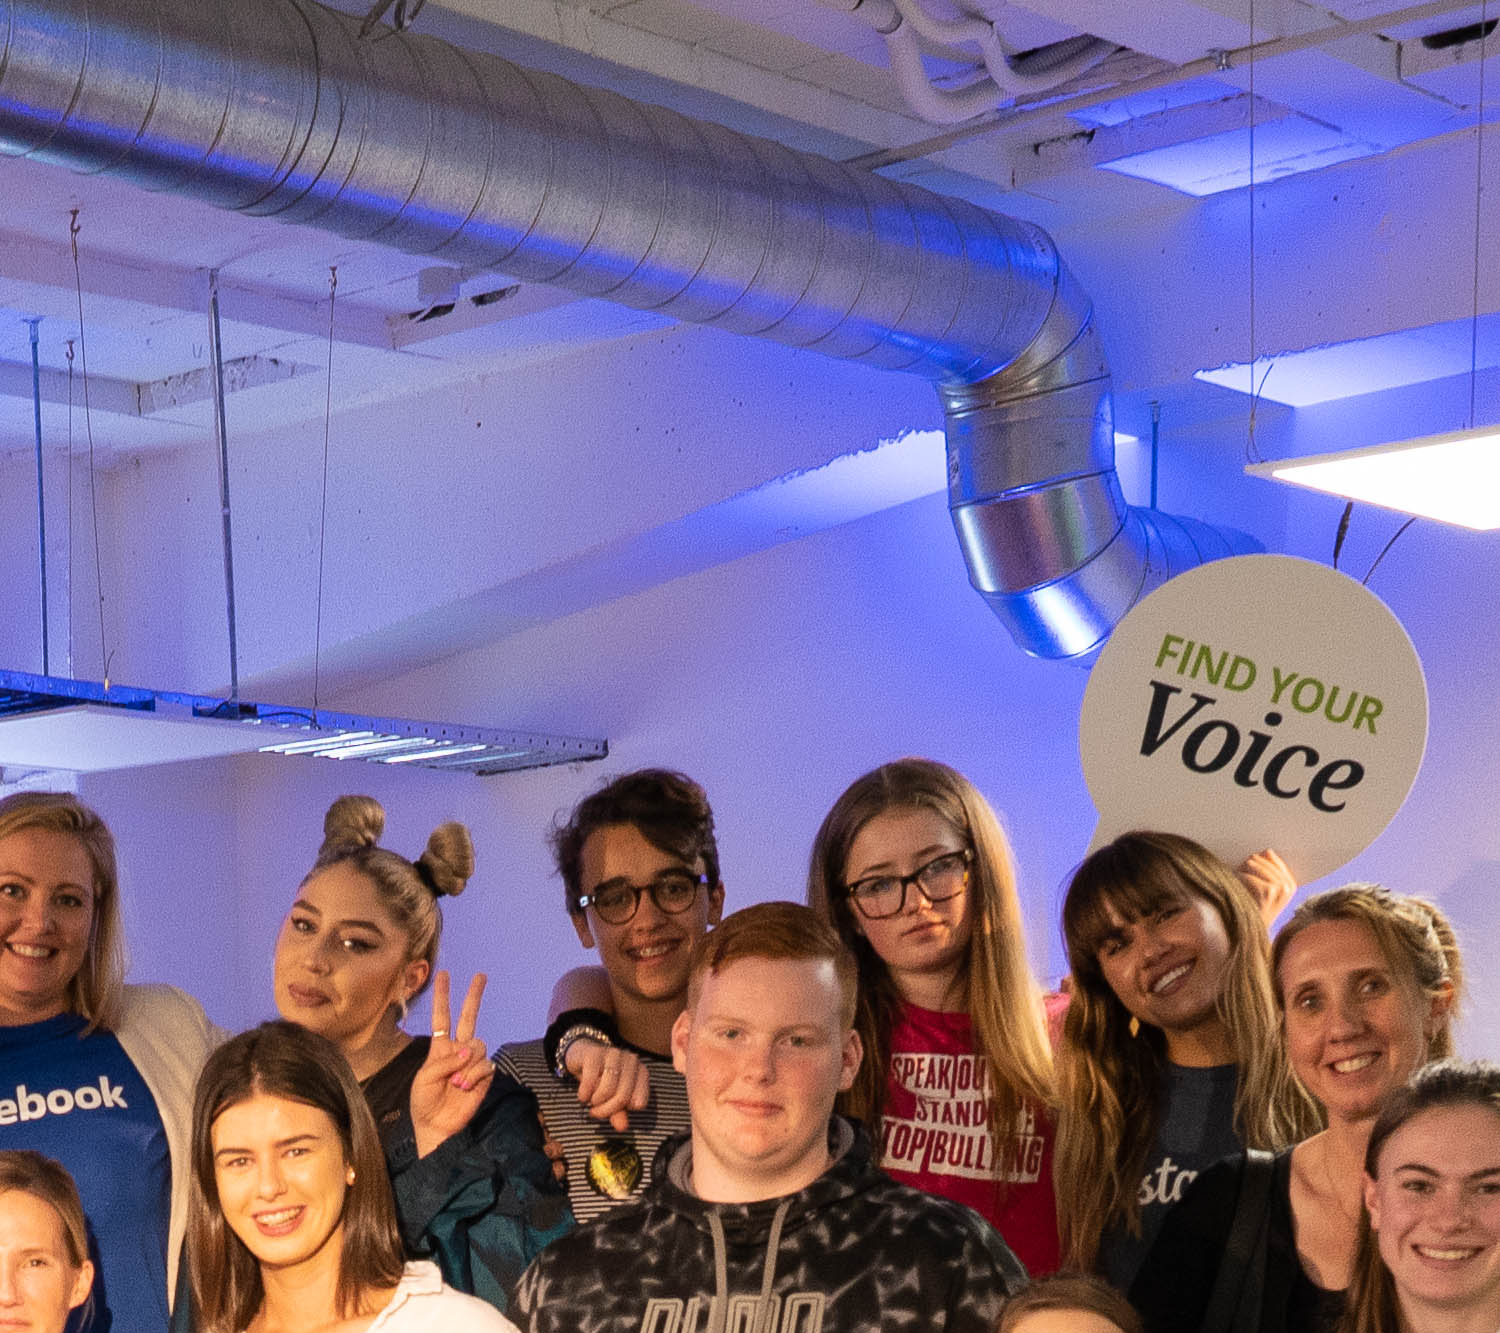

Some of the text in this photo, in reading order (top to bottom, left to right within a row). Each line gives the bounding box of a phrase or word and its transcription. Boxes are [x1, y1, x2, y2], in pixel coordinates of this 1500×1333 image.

[1154, 633, 1383, 735] FIND YOUR
[1139, 679, 1365, 813] Voice
[892, 1056, 951, 1091] SPEAK
[883, 1119, 927, 1161] TOP
